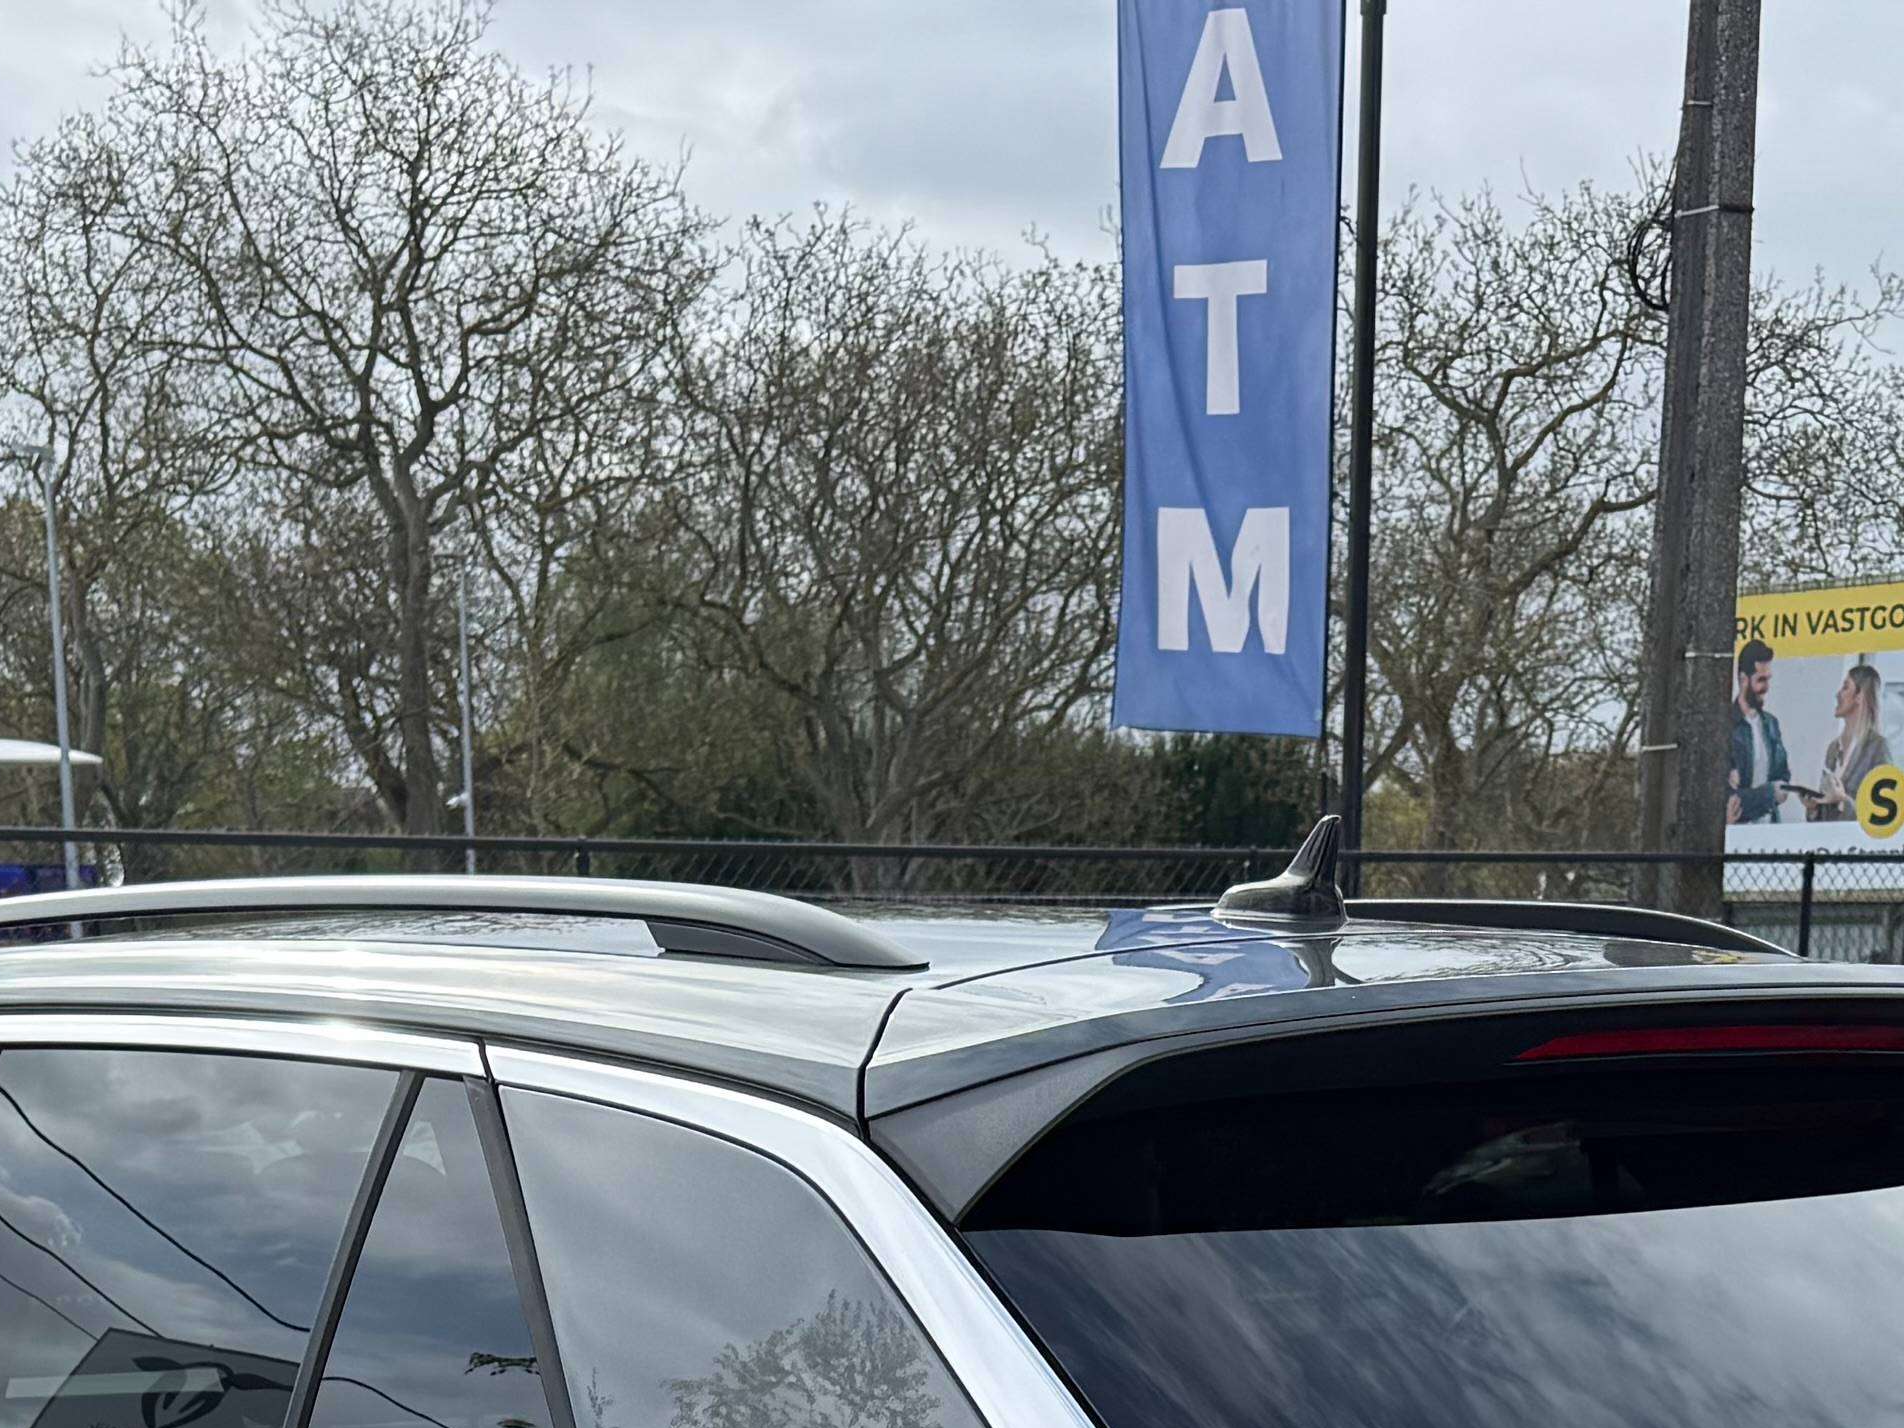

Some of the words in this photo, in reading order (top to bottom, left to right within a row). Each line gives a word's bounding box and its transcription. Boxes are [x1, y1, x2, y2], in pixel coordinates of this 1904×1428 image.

[1158, 6, 1291, 655] ATM
[1772, 612, 1798, 638] IN
[1868, 778, 1898, 827] S
